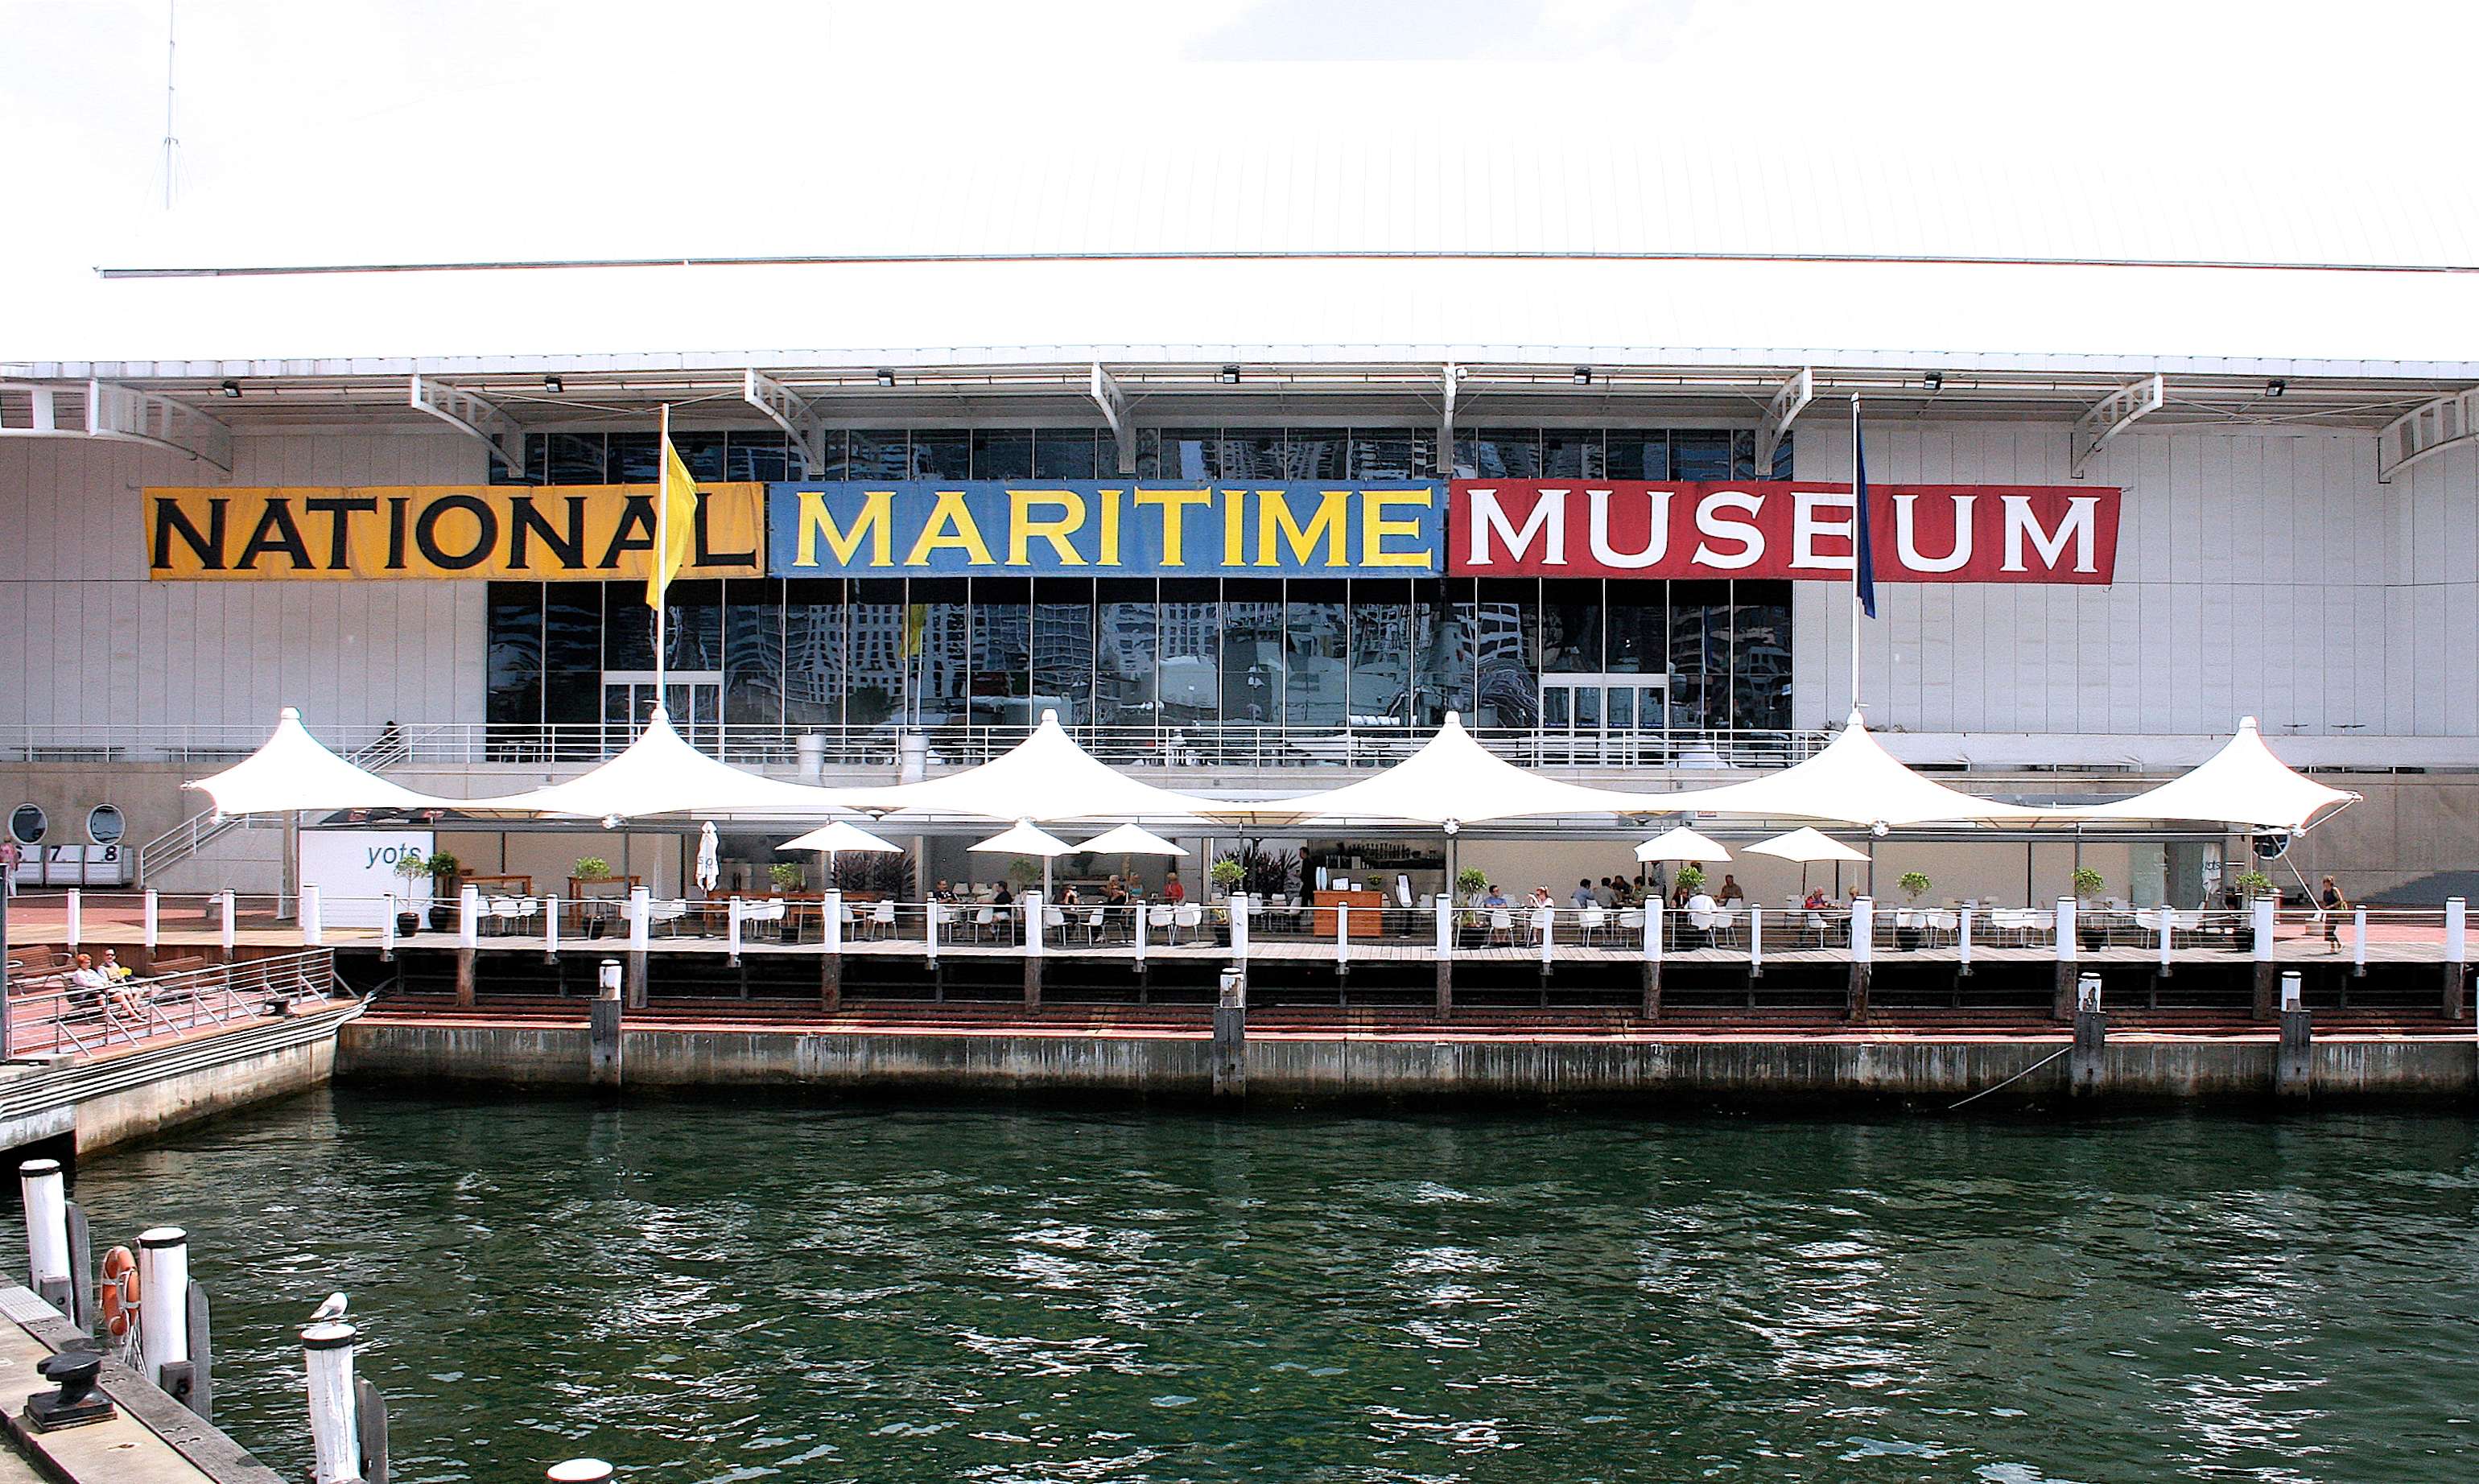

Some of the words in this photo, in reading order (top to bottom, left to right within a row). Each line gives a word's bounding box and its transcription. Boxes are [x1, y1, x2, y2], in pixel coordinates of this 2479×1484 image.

[151, 493, 757, 571] NATIONAL
[791, 485, 1433, 570] MARITIME
[1466, 488, 2102, 574] MUSEUM
[50, 845, 61, 861] 7
[105, 845, 118, 861] 8
[365, 843, 422, 869] yots
